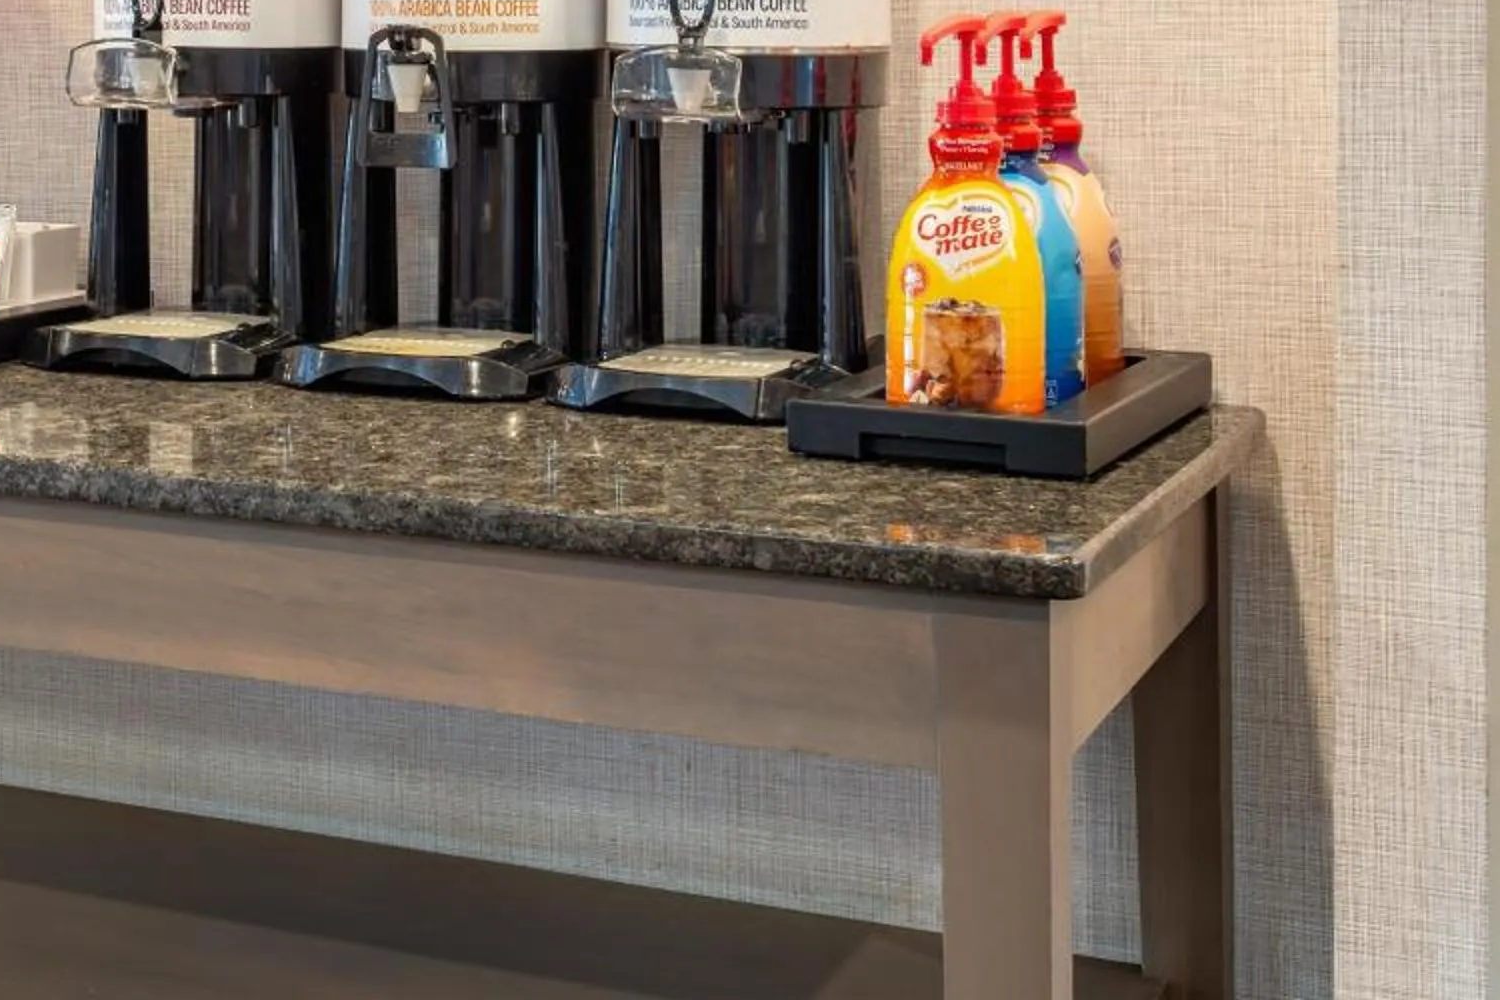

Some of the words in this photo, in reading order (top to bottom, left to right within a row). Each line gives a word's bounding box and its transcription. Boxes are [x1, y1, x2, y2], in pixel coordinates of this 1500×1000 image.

[399, 0, 451, 17] ARABICA
[455, 0, 491, 17] BEAN
[496, 0, 540, 17] COFFEE
[721, 17, 729, 28] &
[731, 17, 763, 28] South
[765, 17, 809, 29] America
[917, 213, 1001, 241] Coffee
[935, 229, 1003, 256] mate
